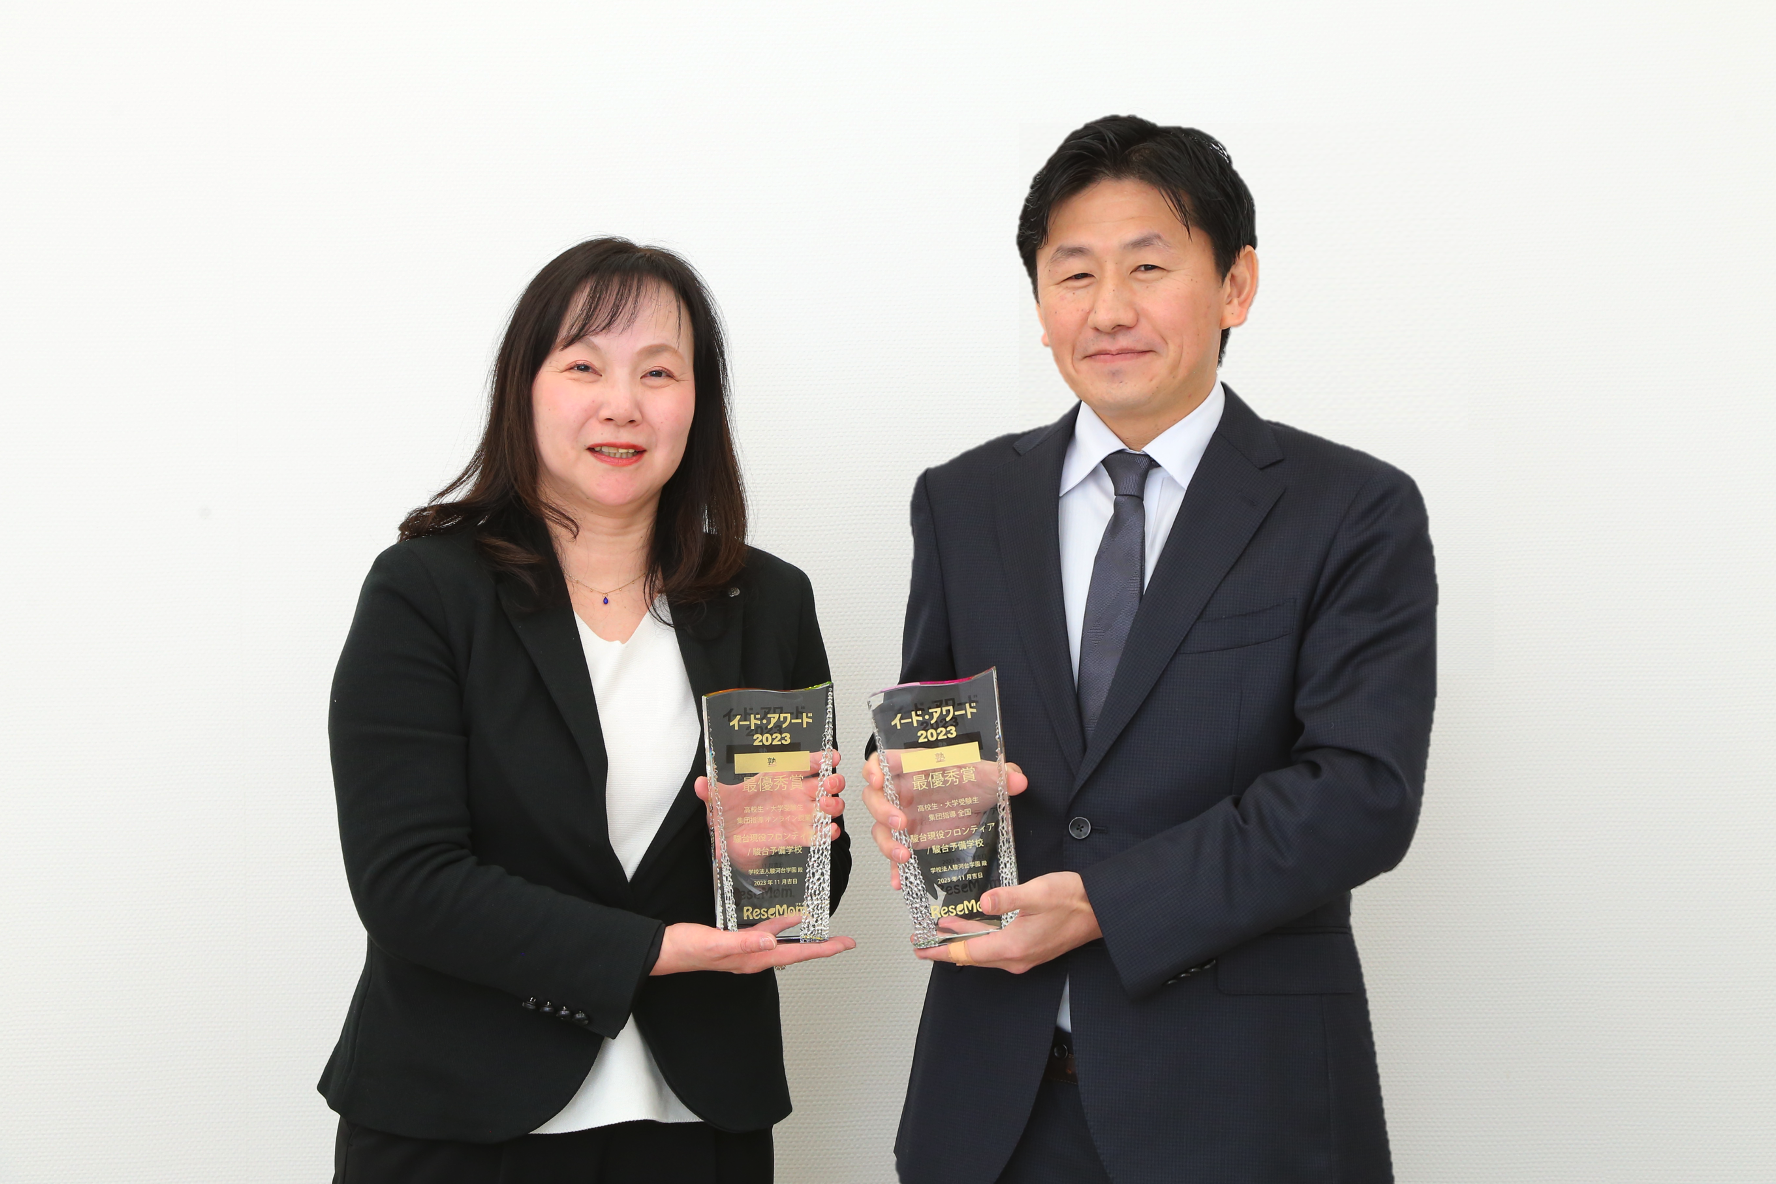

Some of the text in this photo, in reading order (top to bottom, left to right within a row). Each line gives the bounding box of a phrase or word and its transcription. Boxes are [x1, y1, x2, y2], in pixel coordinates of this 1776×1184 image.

[730, 712, 813, 730] イード・アワード
[891, 702, 977, 730] イード・アワード
[753, 732, 791, 746] 2023
[917, 725, 957, 743] 2023
[742, 774, 804, 792] 最優秀賞
[912, 766, 977, 791] 最優秀賞
[917, 796, 979, 812] 高校生・大学受験生
[733, 831, 815, 844] 駿台現役フロンティ
[909, 822, 995, 844] 駿台現役フロンティア
